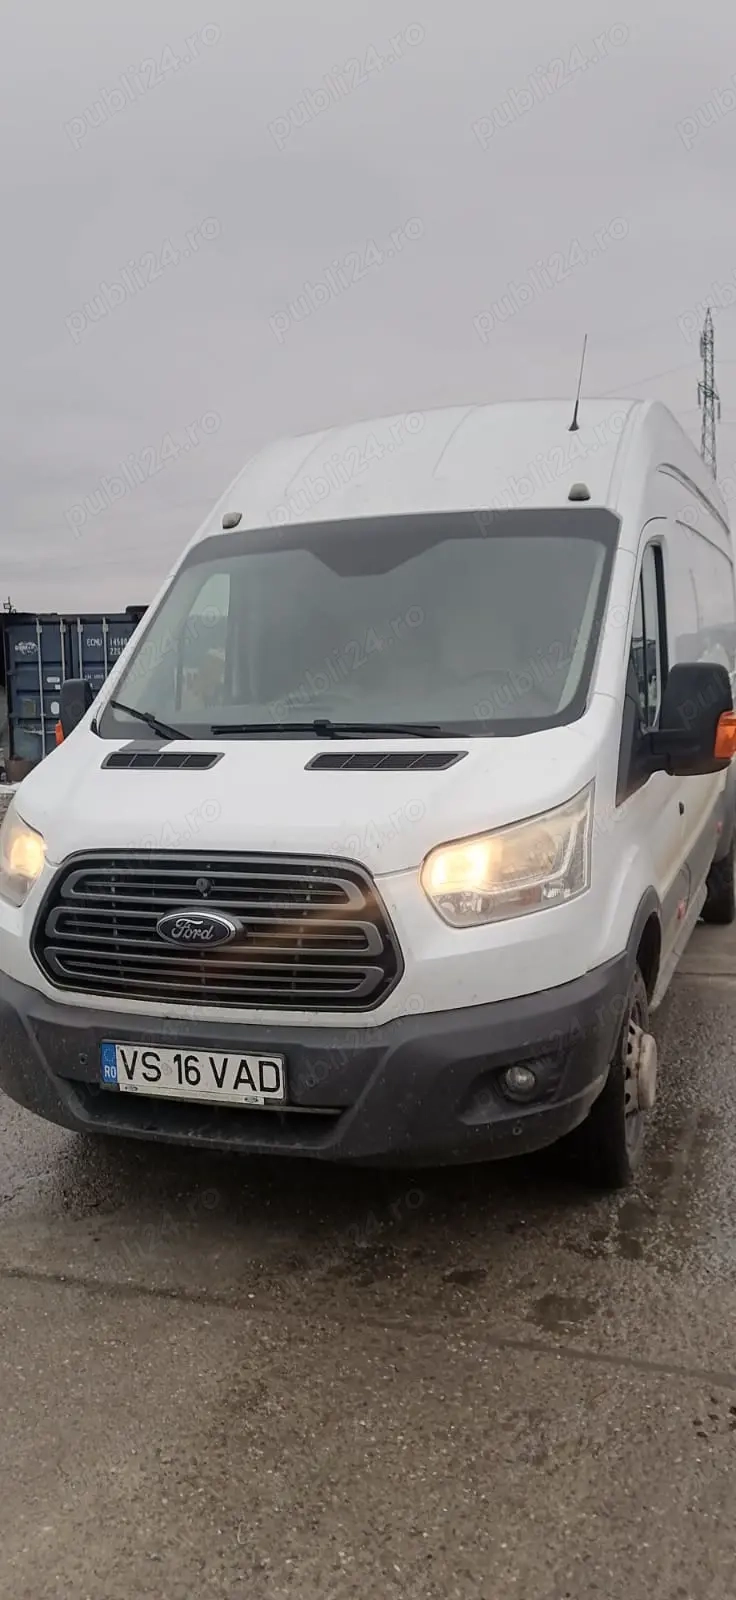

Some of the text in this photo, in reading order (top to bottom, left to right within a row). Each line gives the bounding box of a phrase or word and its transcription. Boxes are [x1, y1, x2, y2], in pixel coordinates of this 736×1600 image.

[171, 918, 215, 941] Ford
[104, 1049, 282, 1093] RO VS 16 VAD
